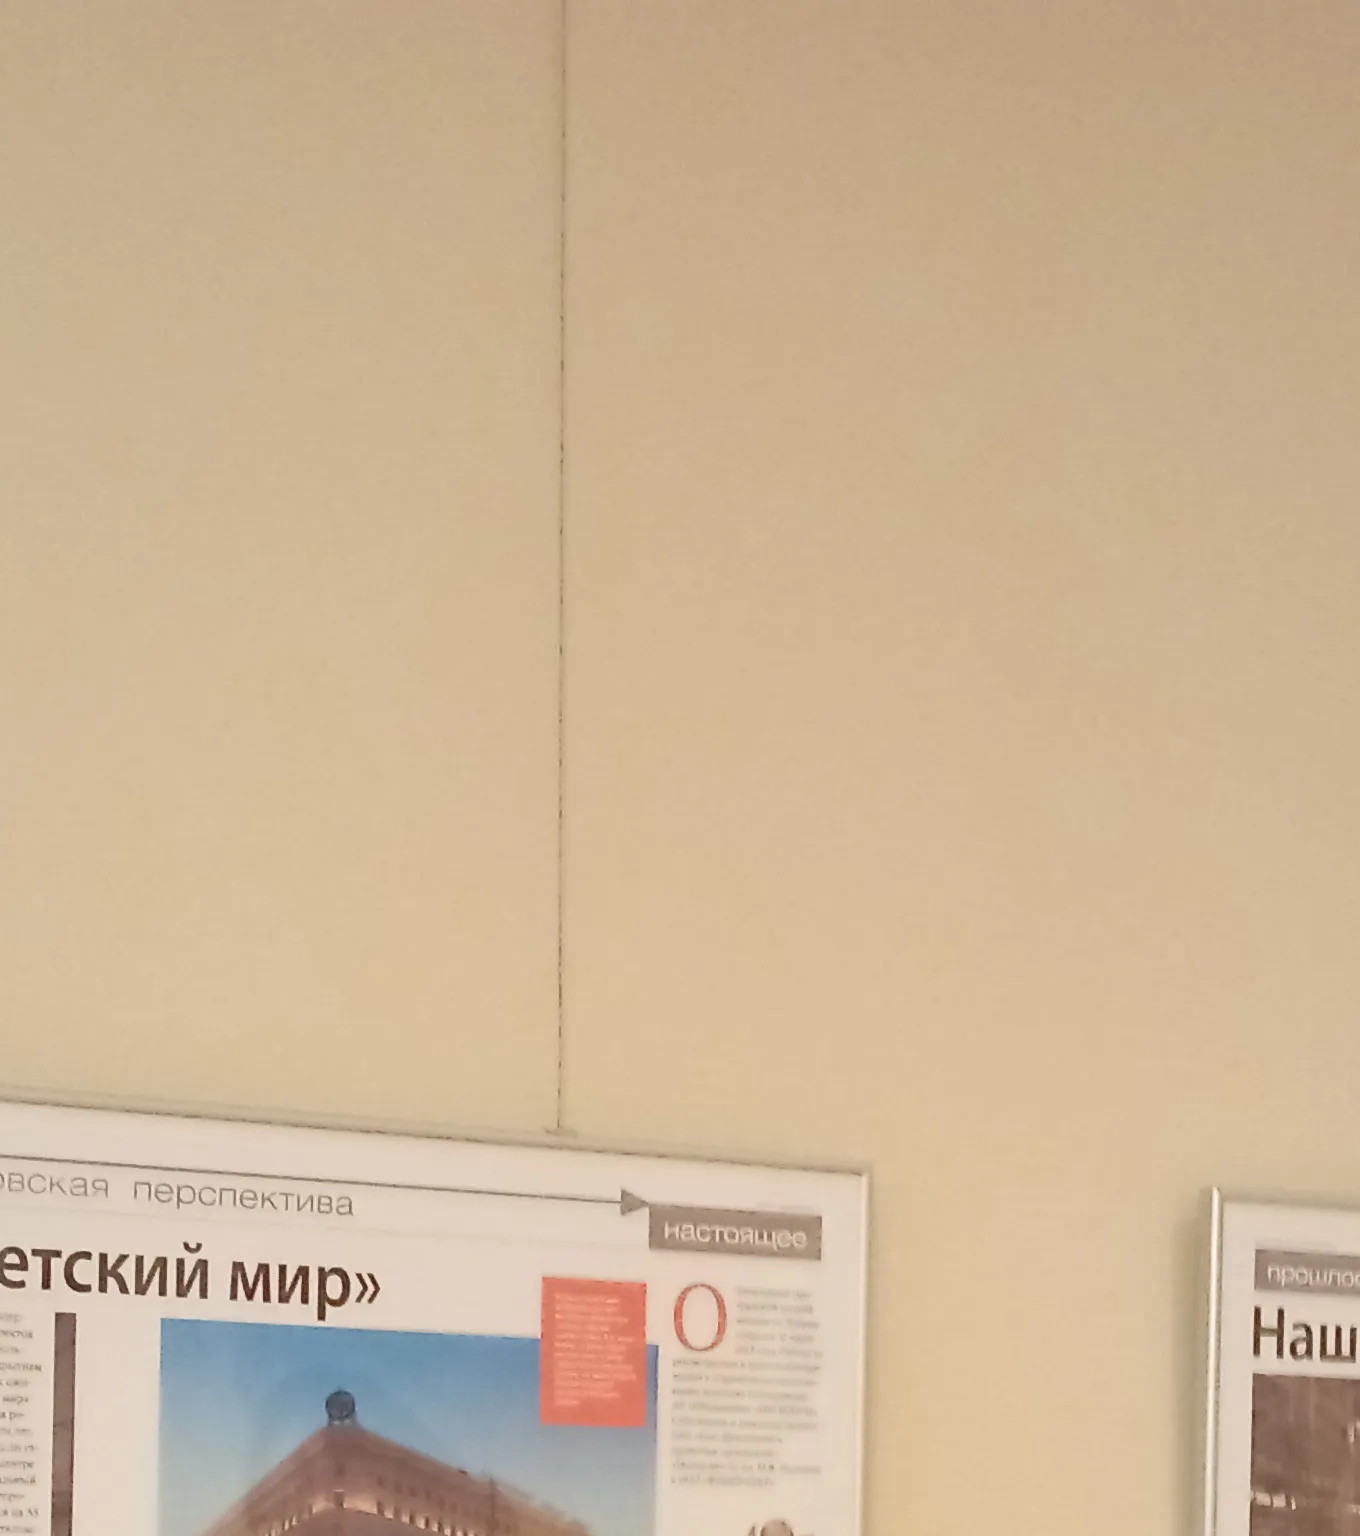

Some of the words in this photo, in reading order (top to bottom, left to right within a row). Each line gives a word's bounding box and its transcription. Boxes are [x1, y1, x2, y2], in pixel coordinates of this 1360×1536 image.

[133, 1180, 356, 1217] перспектива
[664, 1220, 808, 1251] настоящее
[230, 1261, 382, 1321] мир»
